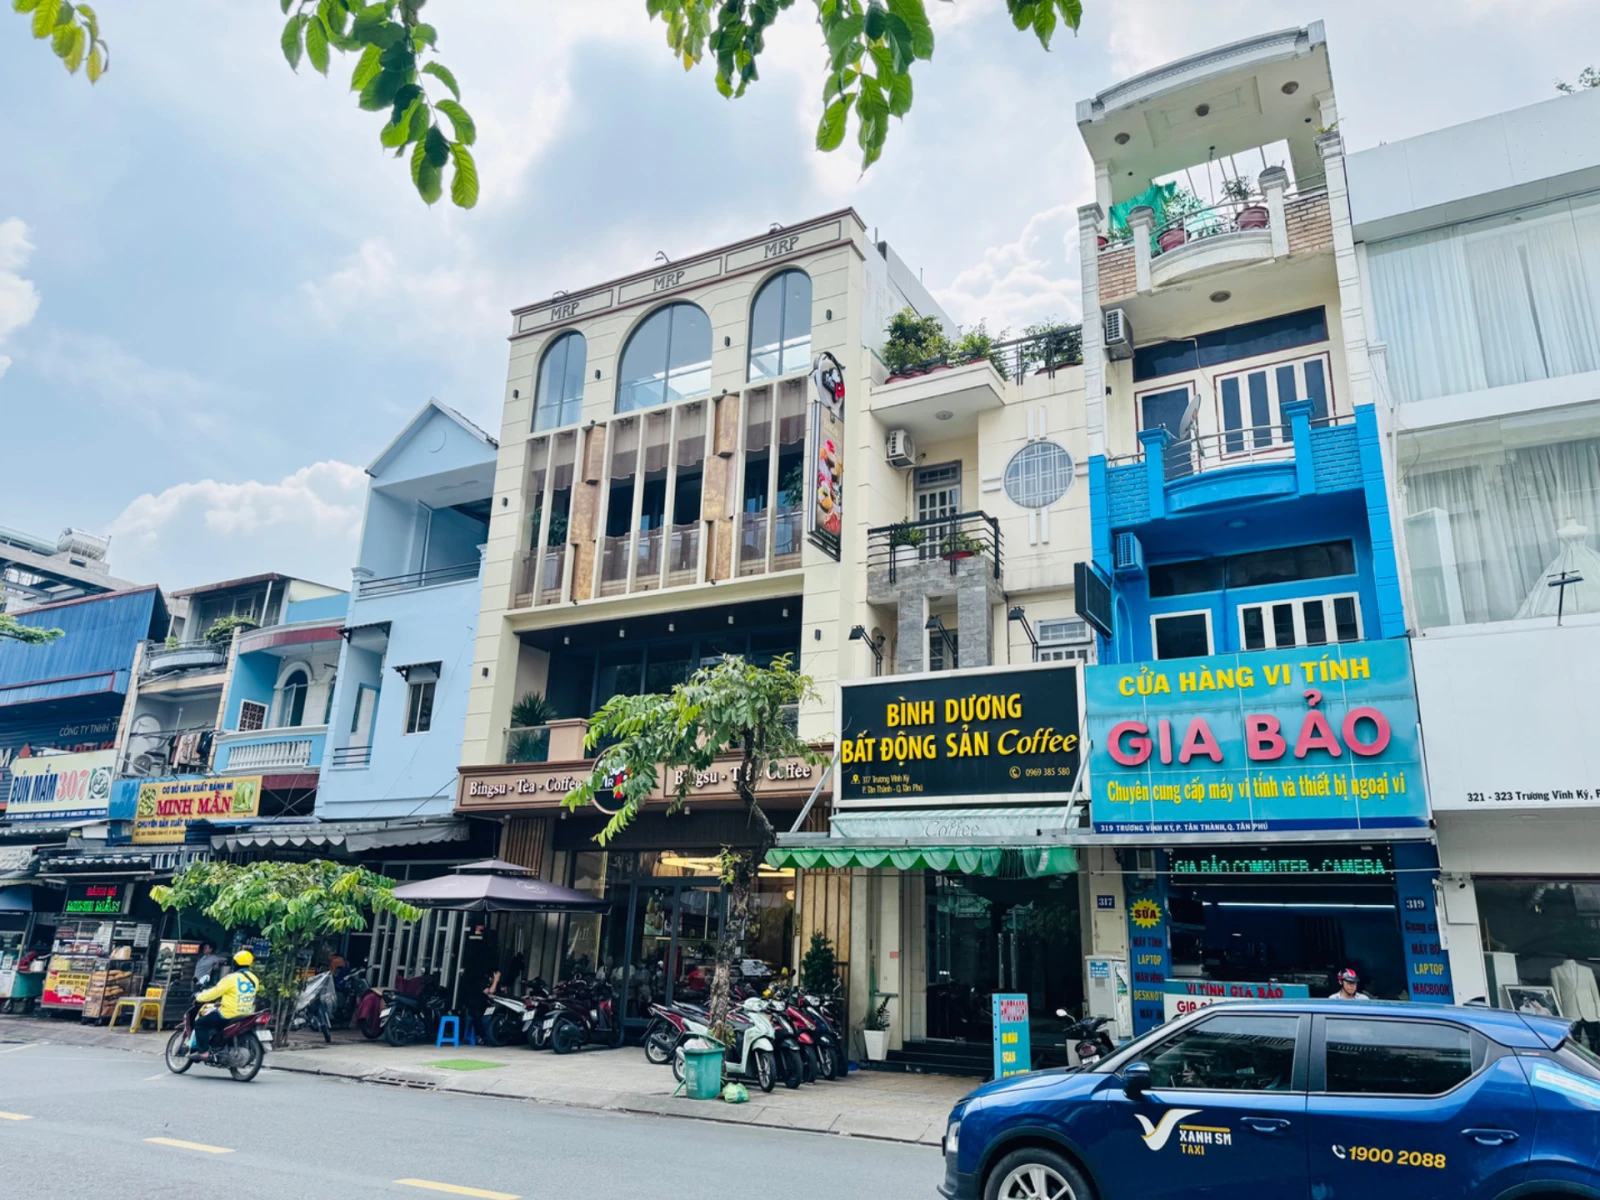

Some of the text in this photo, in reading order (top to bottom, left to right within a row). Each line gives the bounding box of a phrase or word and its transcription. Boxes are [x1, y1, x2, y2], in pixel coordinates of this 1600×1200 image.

[763, 236, 799, 258] MRP
[652, 270, 685, 291] MRP
[550, 301, 580, 321] MRP
[1118, 654, 1371, 697] CỬA HÀNG VI TÍNH
[886, 693, 1023, 728] BÌNH DƯƠNG
[80, 725, 89, 734] TY
[1107, 689, 1391, 767] GIA BẢO
[841, 725, 1078, 766] BẤT ĐỘNG SẢN Coffee
[674, 770, 718, 788] Bgsu
[1025, 768, 1042, 777] 0969
[1057, 767, 1071, 776] 580
[10, 764, 91, 804] BÚN MẮM 307
[469, 781, 507, 798] Bingsu
[516, 779, 537, 795] Tea
[545, 776, 584, 793] Coffee
[1107, 772, 1406, 805] Chuyên cung cấp máy vi tính và thiết bị ngoại vi
[1467, 793, 1486, 802] 321
[1494, 792, 1513, 801] 323
[1515, 791, 1550, 801] Trương
[1552, 790, 1574, 800] Vĩnh
[156, 799, 195, 816] MINH
[1100, 824, 1114, 832] 319
[1116, 823, 1144, 832] TRƯƠNG
[1185, 822, 1198, 831] TÂN
[1236, 821, 1250, 831] TÂN
[1253, 821, 1268, 831] PHÚ
[1175, 860, 1197, 873] GIA
[1233, 860, 1309, 873] COMPUTER
[1322, 859, 1385, 874] CAMERA
[1099, 898, 1113, 907] 317
[1406, 899, 1425, 909] 319
[1134, 906, 1157, 919] SỬA
[1137, 954, 1162, 966] LAPTOP
[1414, 963, 1444, 975] LAPTOP
[237, 976, 255, 993] be
[1187, 981, 1283, 998] VI TÍNH GIA BẢO
[1412, 982, 1450, 995] MACBOOK
[1134, 989, 1165, 1001] DESKNOT
[1177, 1000, 1197, 1013] GIA
[1179, 1129, 1232, 1146] XANH SM
[1180, 1143, 1205, 1156] TAXI
[1349, 1146, 1447, 1169] 1900 2088
